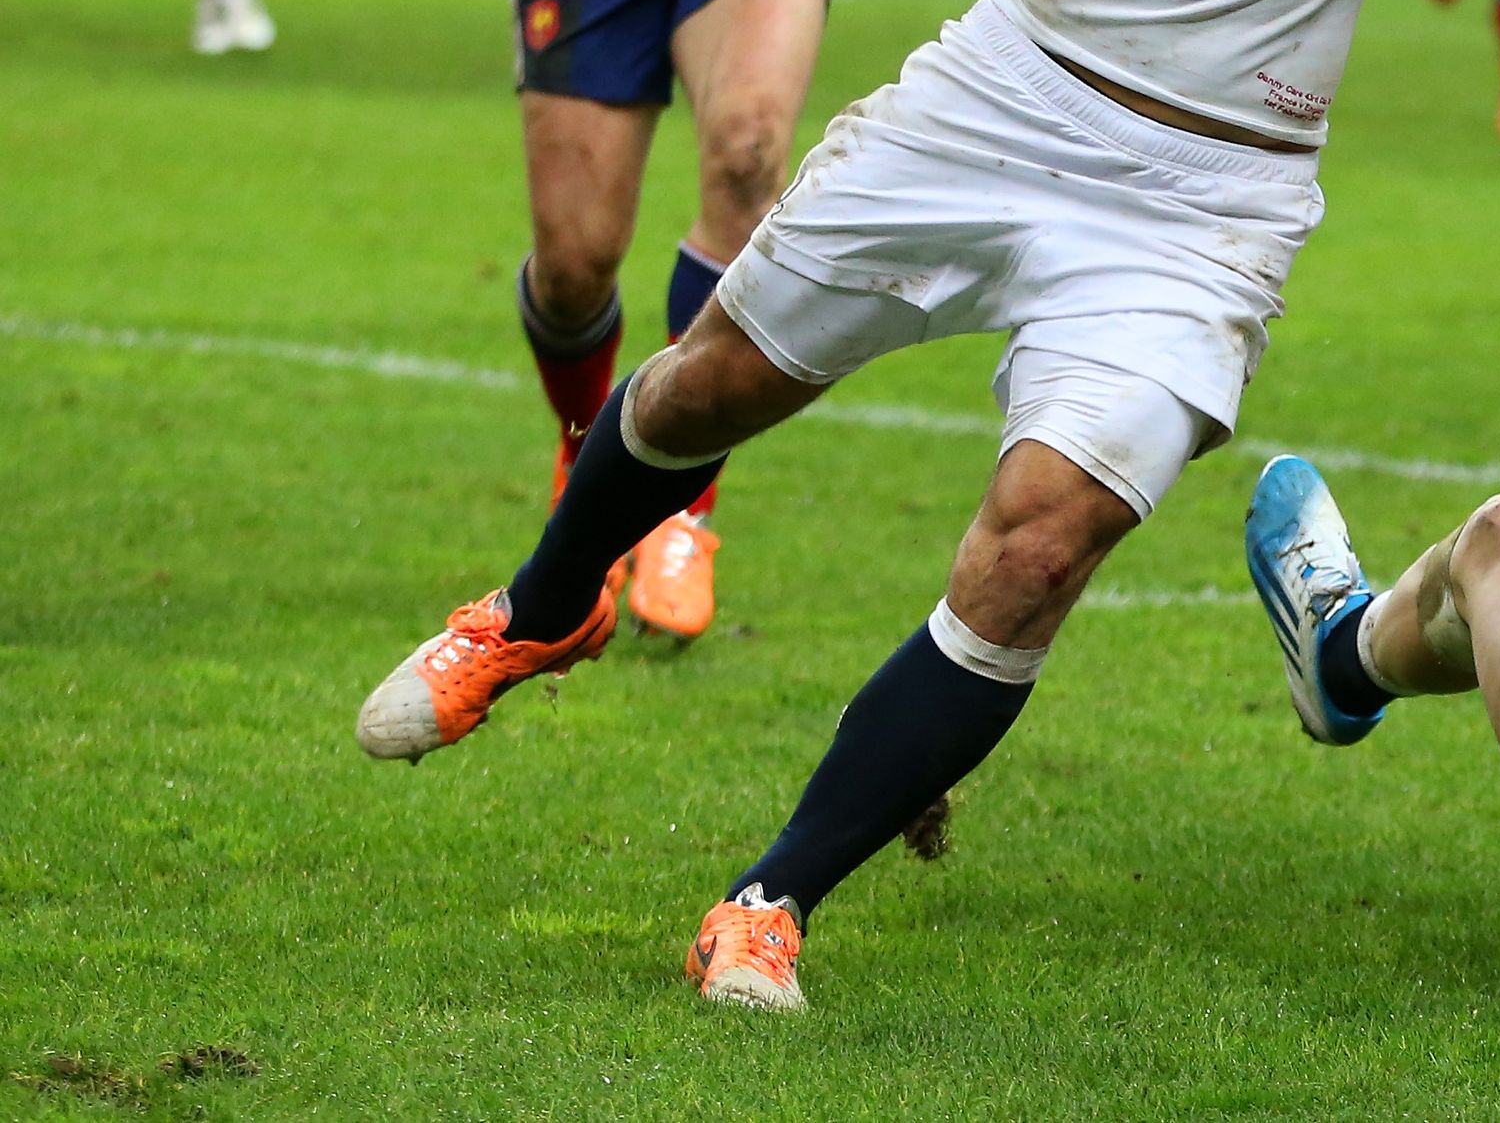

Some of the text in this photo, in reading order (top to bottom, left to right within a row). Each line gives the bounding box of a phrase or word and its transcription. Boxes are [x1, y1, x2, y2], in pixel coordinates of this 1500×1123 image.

[1257, 71, 1285, 90] Danny
[1263, 98, 1277, 110] 1st
[1268, 89, 1298, 107] France
